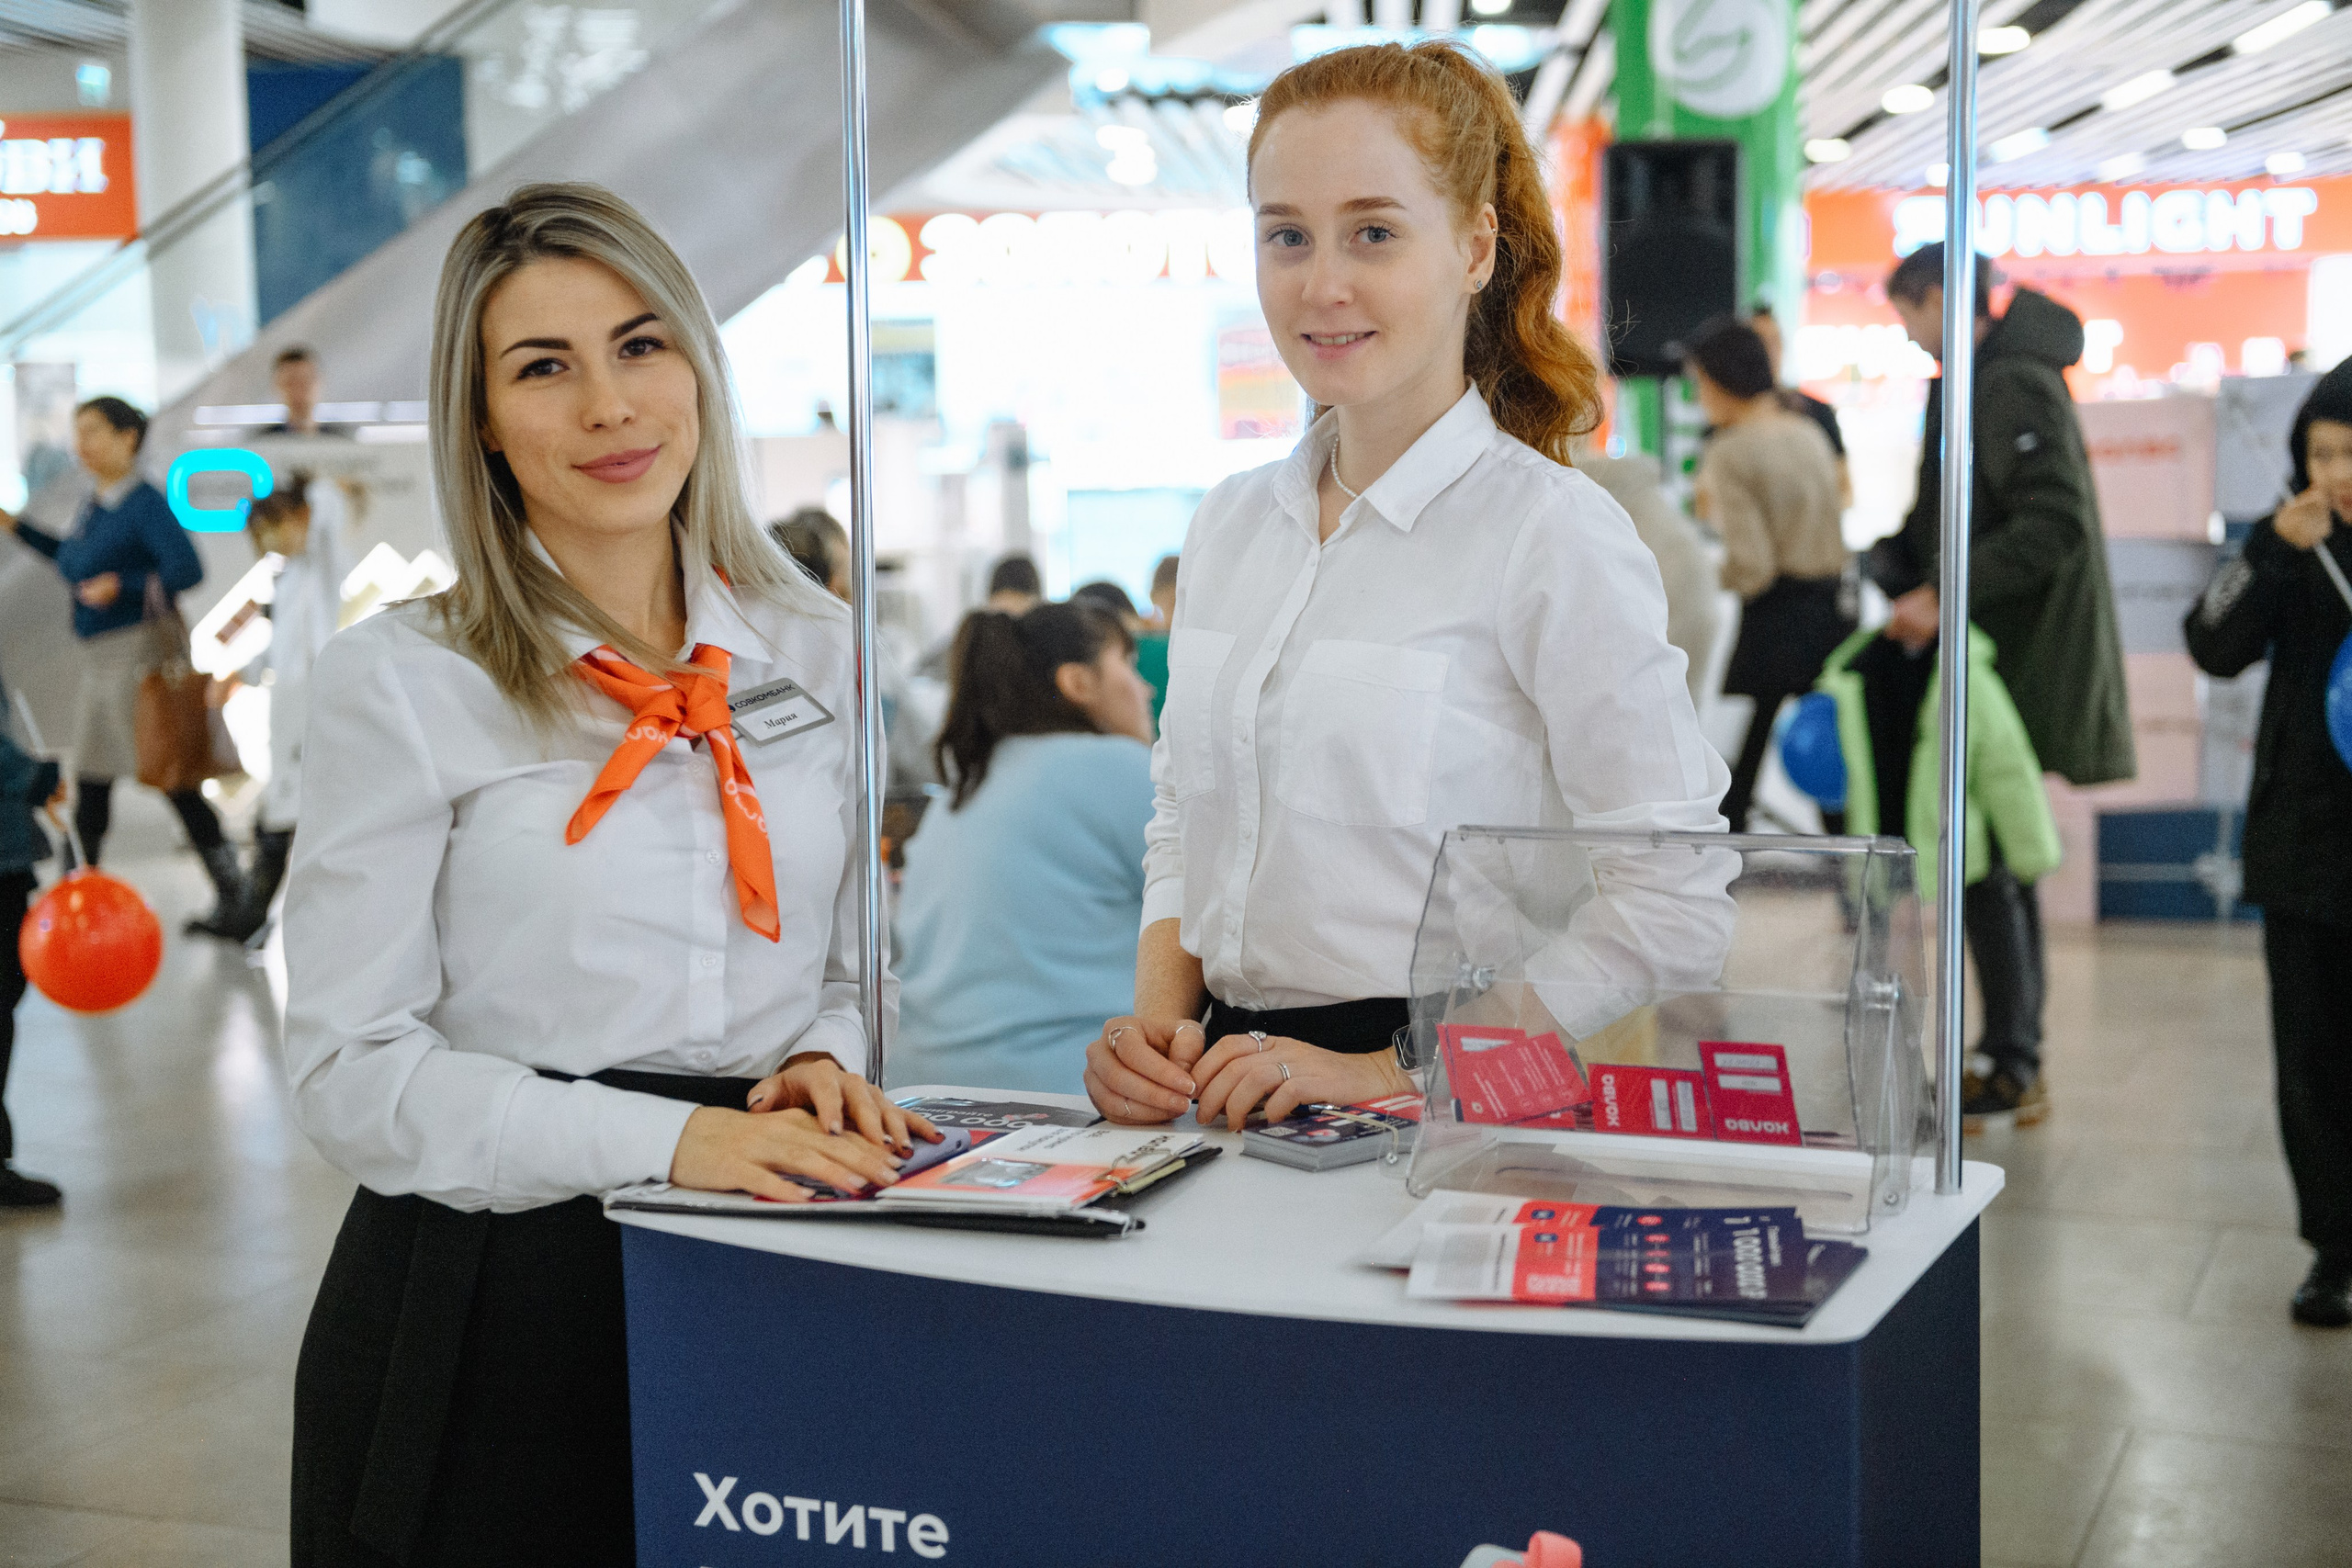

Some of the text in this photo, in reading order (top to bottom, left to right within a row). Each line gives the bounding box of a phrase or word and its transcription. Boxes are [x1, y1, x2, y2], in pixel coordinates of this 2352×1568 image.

[734, 683, 796, 709] СОВКОМБАНК
[763, 713, 798, 729] Мария
[693, 1472, 950, 1560] Хотите
